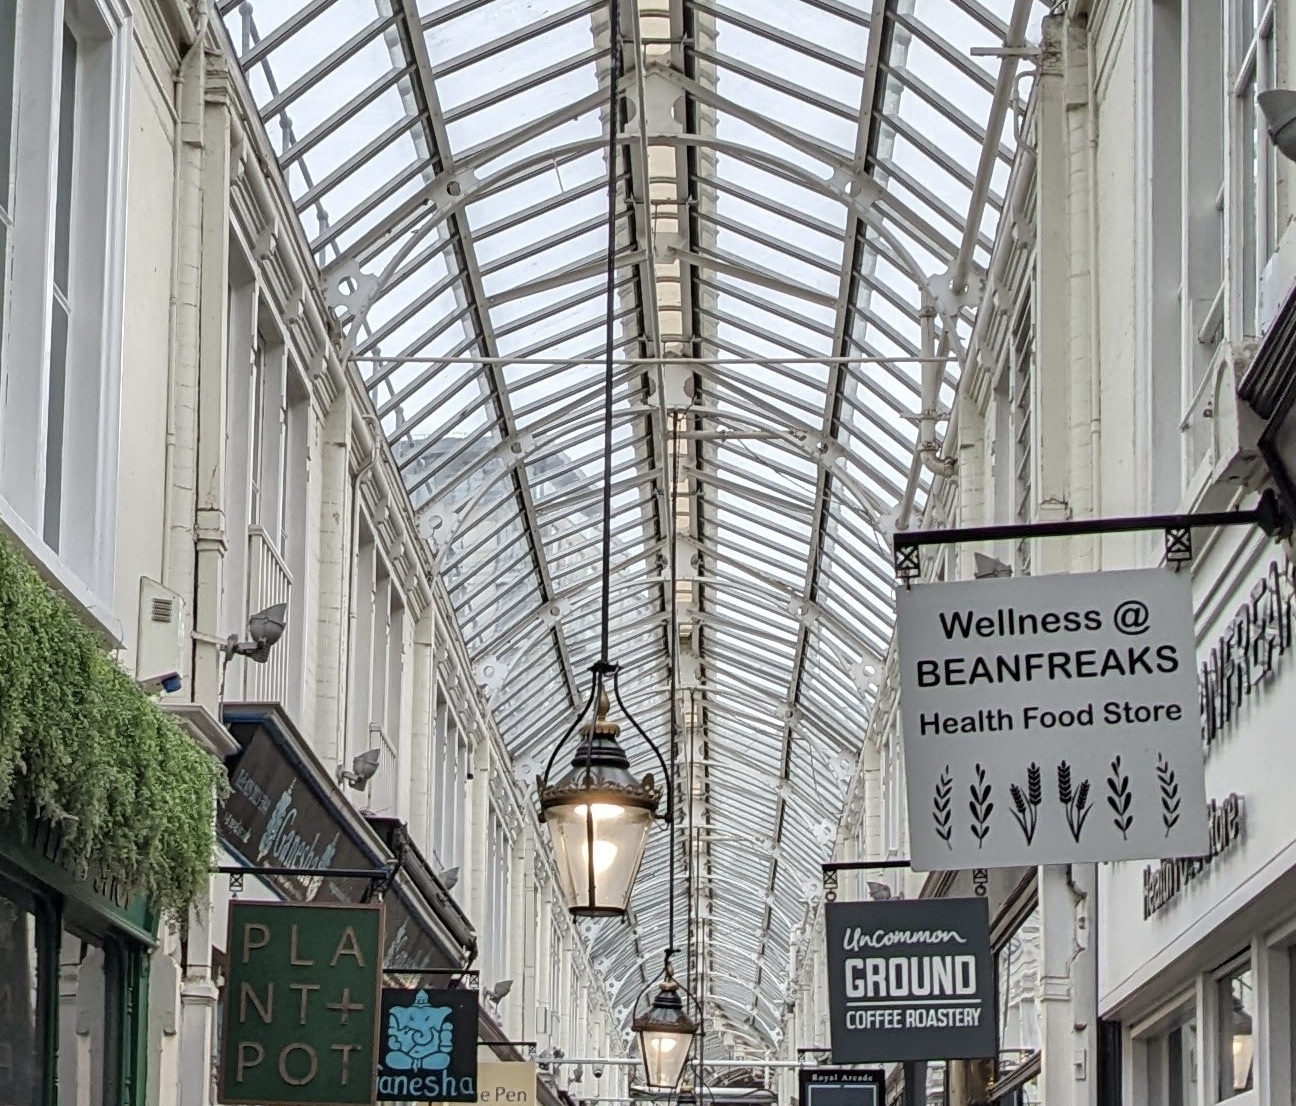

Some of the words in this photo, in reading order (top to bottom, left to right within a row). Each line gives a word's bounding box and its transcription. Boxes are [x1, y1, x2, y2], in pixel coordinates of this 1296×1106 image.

[939, 608, 1103, 640] Wellness
[1113, 600, 1151, 636] @
[916, 645, 1179, 688] BEANFREAKS
[919, 707, 1014, 736] Health
[1023, 703, 1094, 730] Food
[1103, 701, 1183, 725] Store
[844, 955, 977, 998] GROUND
[846, 1010, 903, 1029] COFFEE
[906, 1007, 982, 1028] ROASTERY
[235, 1040, 363, 1087] POT
[811, 1073, 838, 1083] Royal
[840, 1073, 873, 1082] Arcade
[495, 1086, 528, 1103] Pen
